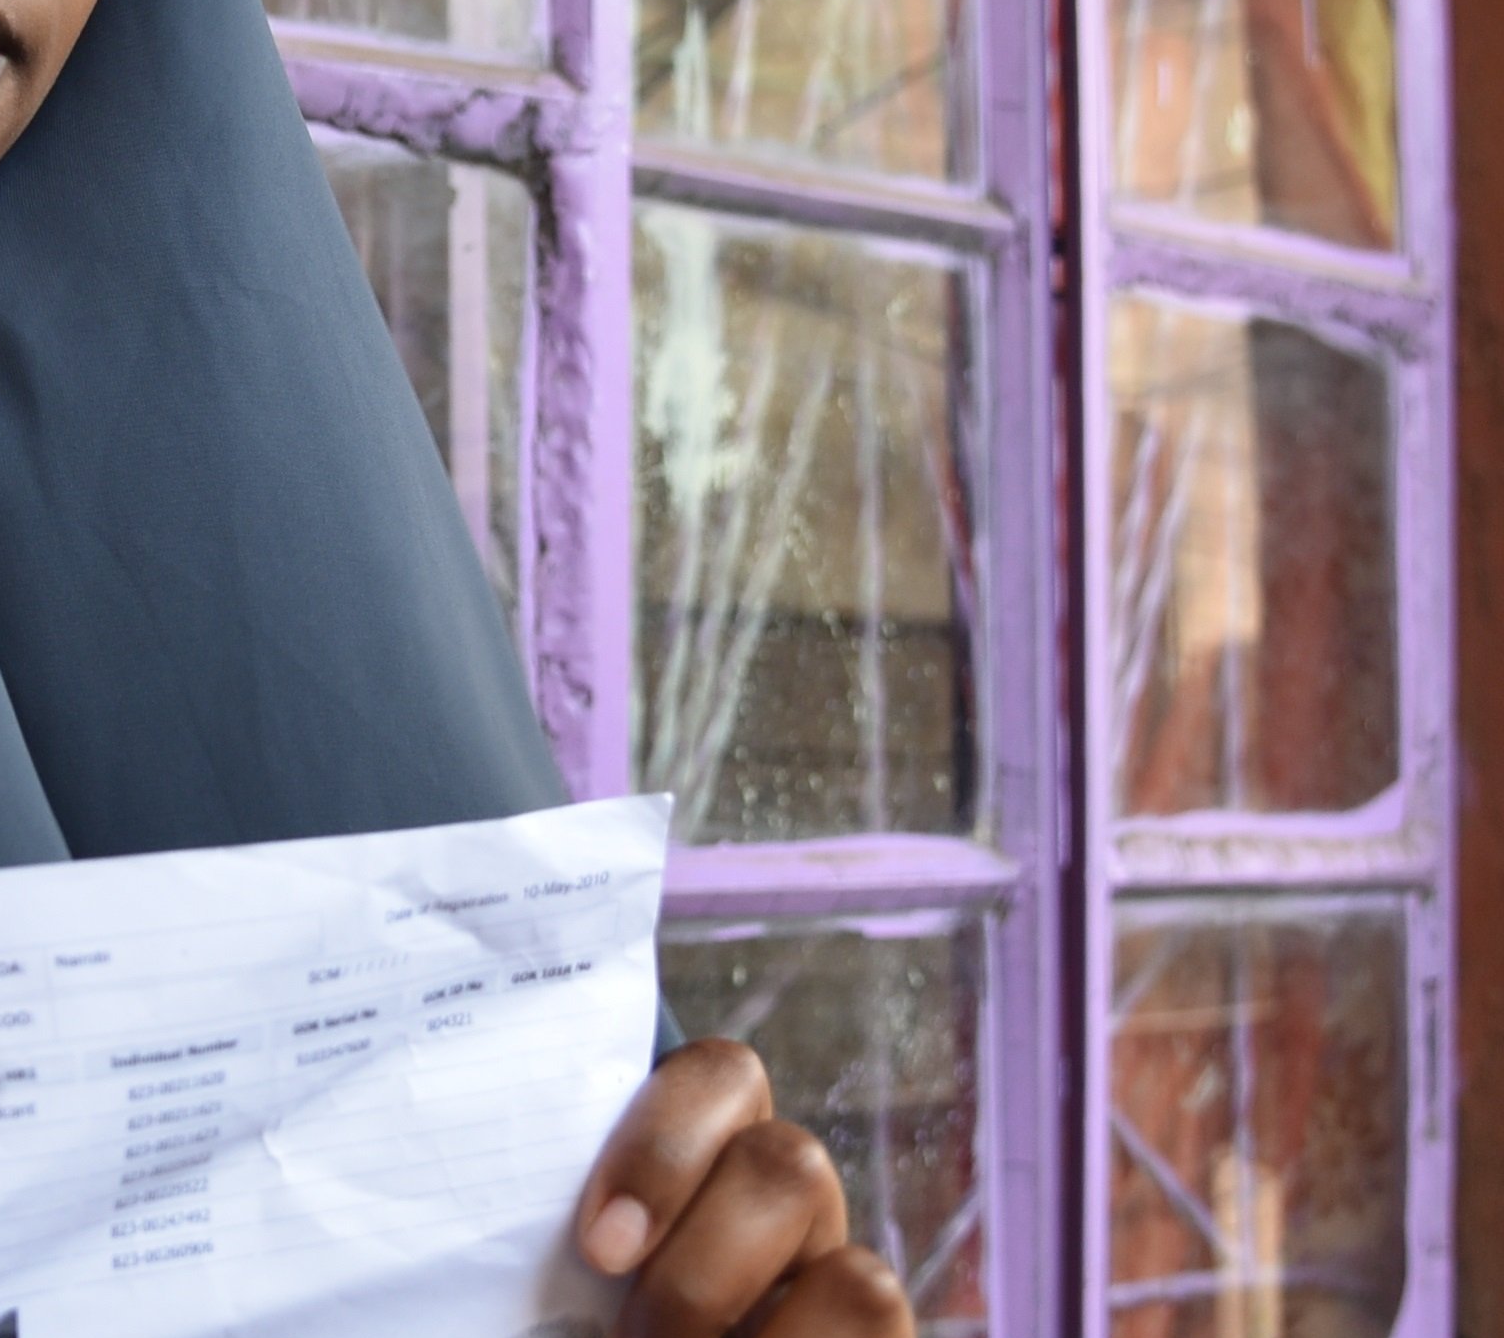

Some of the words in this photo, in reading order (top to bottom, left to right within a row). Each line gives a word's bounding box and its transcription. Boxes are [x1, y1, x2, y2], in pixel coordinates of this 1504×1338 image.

[386, 908, 414, 924] Date
[523, 870, 610, 900] 10-May-2010
[110, 1047, 182, 1070] Individual
[187, 1038, 238, 1060] Number
